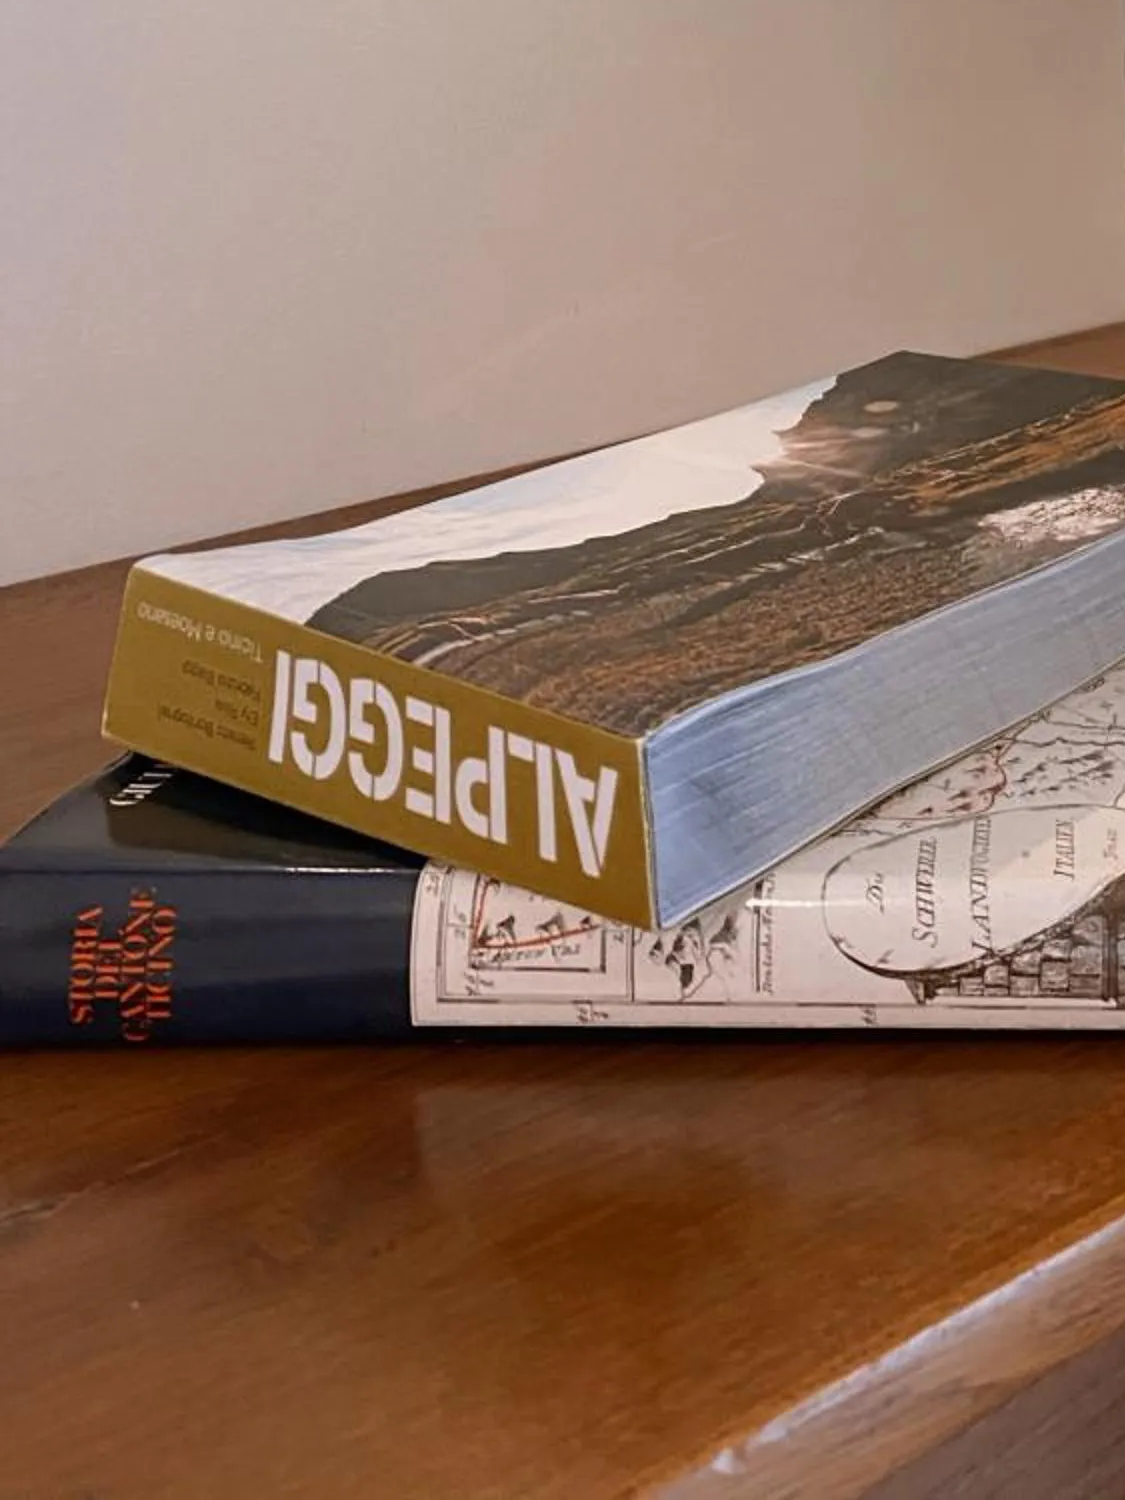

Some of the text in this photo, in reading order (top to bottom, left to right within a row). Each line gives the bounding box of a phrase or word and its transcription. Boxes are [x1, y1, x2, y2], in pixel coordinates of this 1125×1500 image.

[136, 601, 264, 663] Ticino e Moesano
[268, 648, 621, 877] ALPEGGI
[68, 906, 104, 1025] STORIA
[94, 941, 123, 999] DEL
[118, 885, 158, 1042] CANTONE
[146, 907, 177, 1019] TICINO
